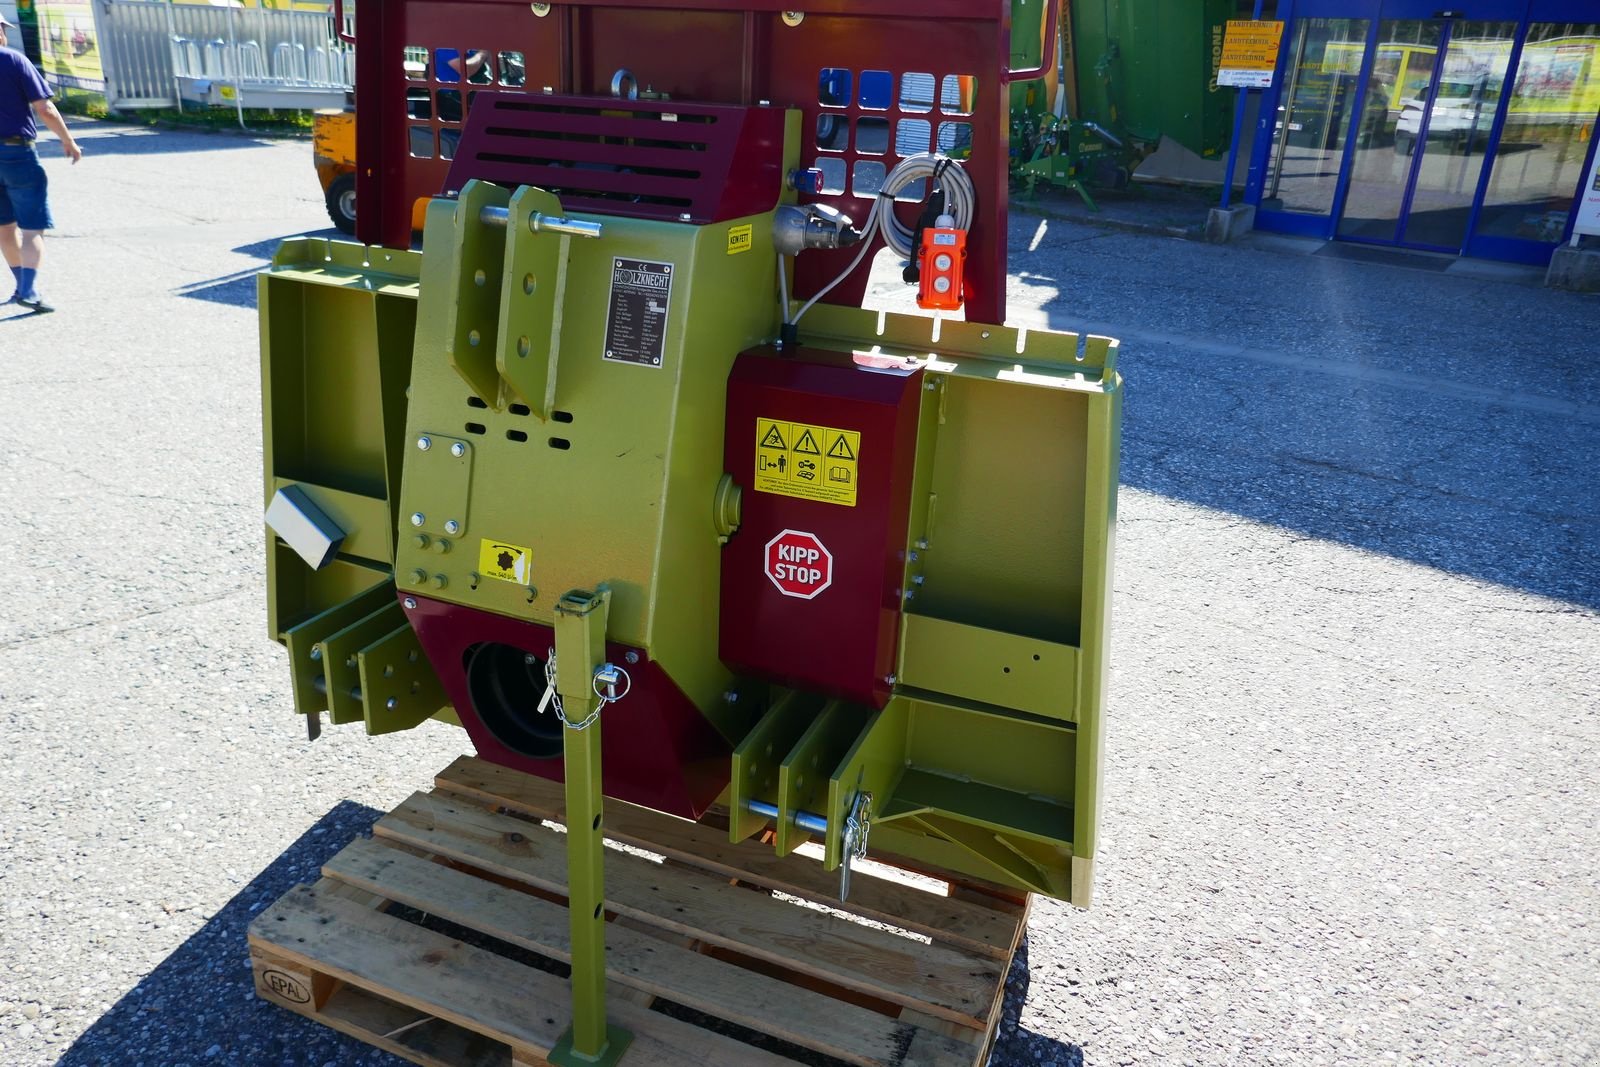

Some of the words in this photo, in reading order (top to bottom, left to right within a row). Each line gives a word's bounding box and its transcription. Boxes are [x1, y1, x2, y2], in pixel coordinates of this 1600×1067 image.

[778, 543, 820, 565] KIPP
[775, 563, 821, 585] STOP
[271, 975, 304, 1001] EPAL
